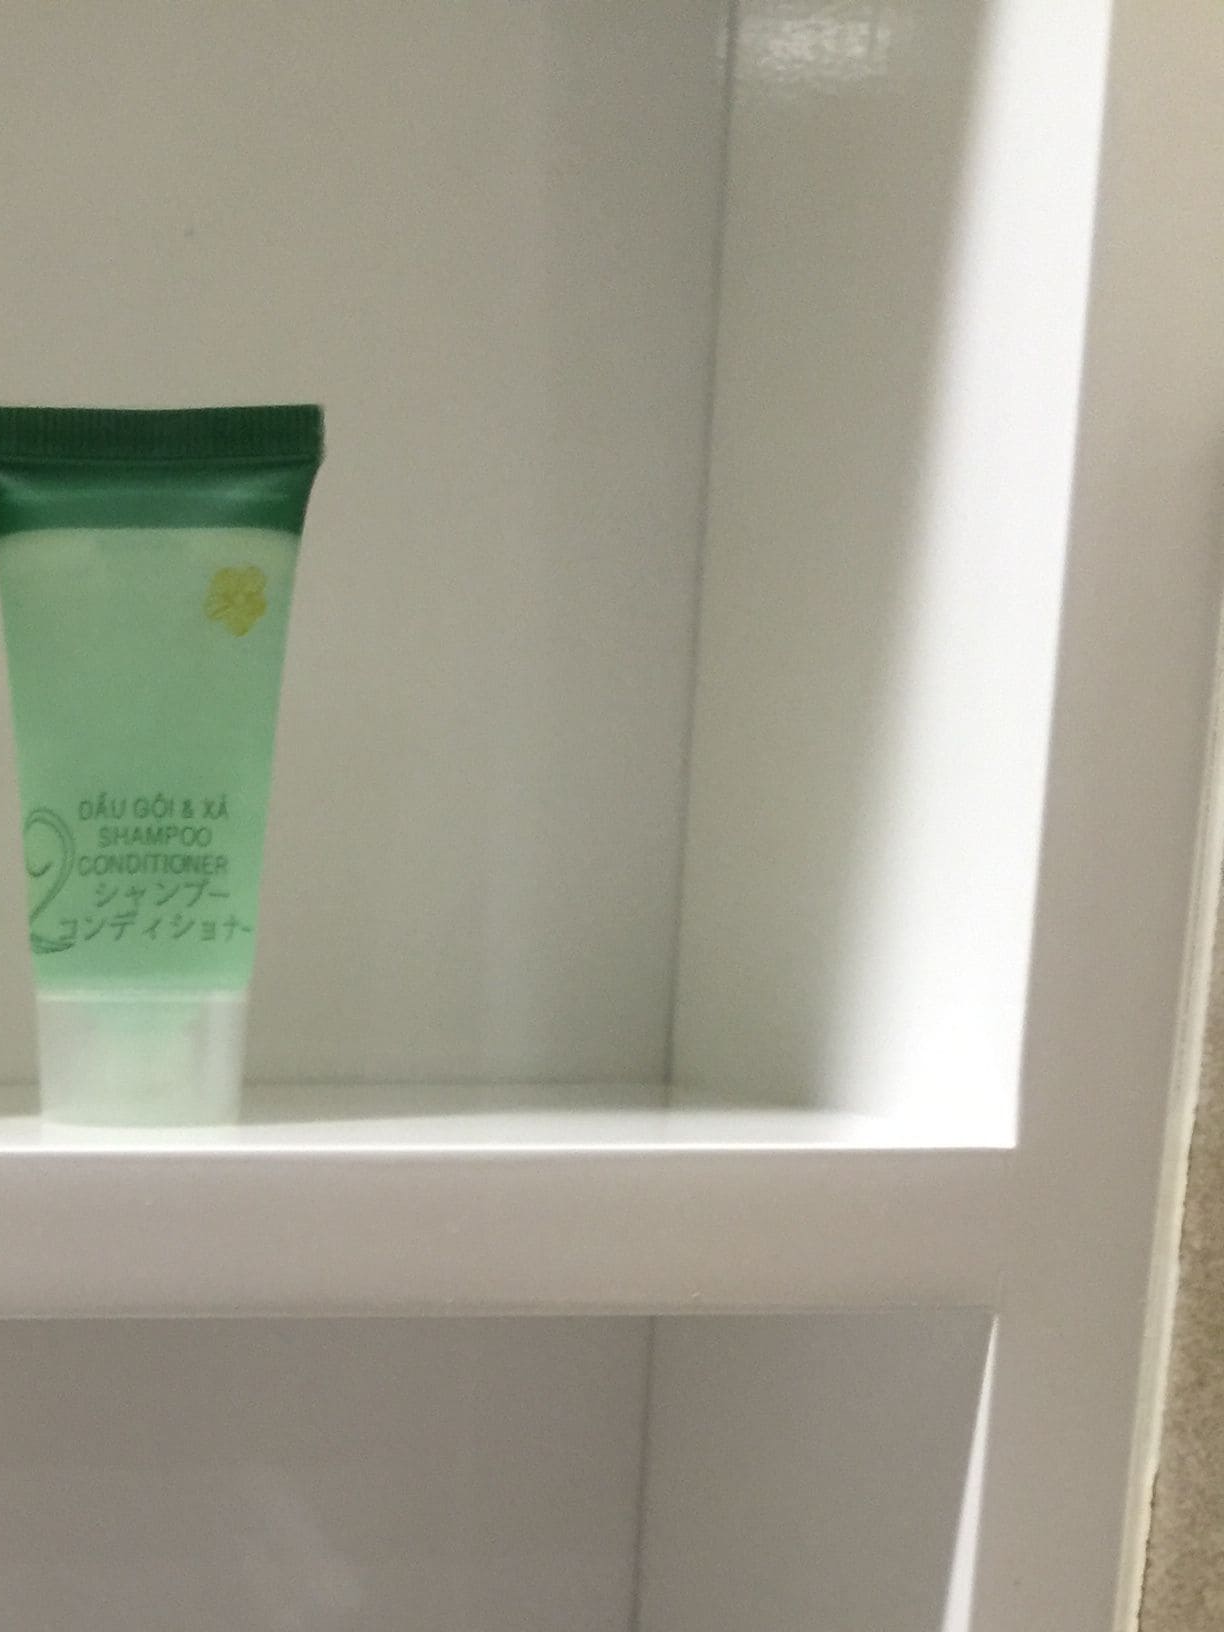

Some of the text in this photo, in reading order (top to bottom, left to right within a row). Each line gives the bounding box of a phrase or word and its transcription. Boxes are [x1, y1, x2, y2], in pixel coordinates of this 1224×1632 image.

[181, 798, 194, 819] &
[98, 825, 213, 849] SHAMPOO
[77, 853, 230, 877] CONDITIONER
